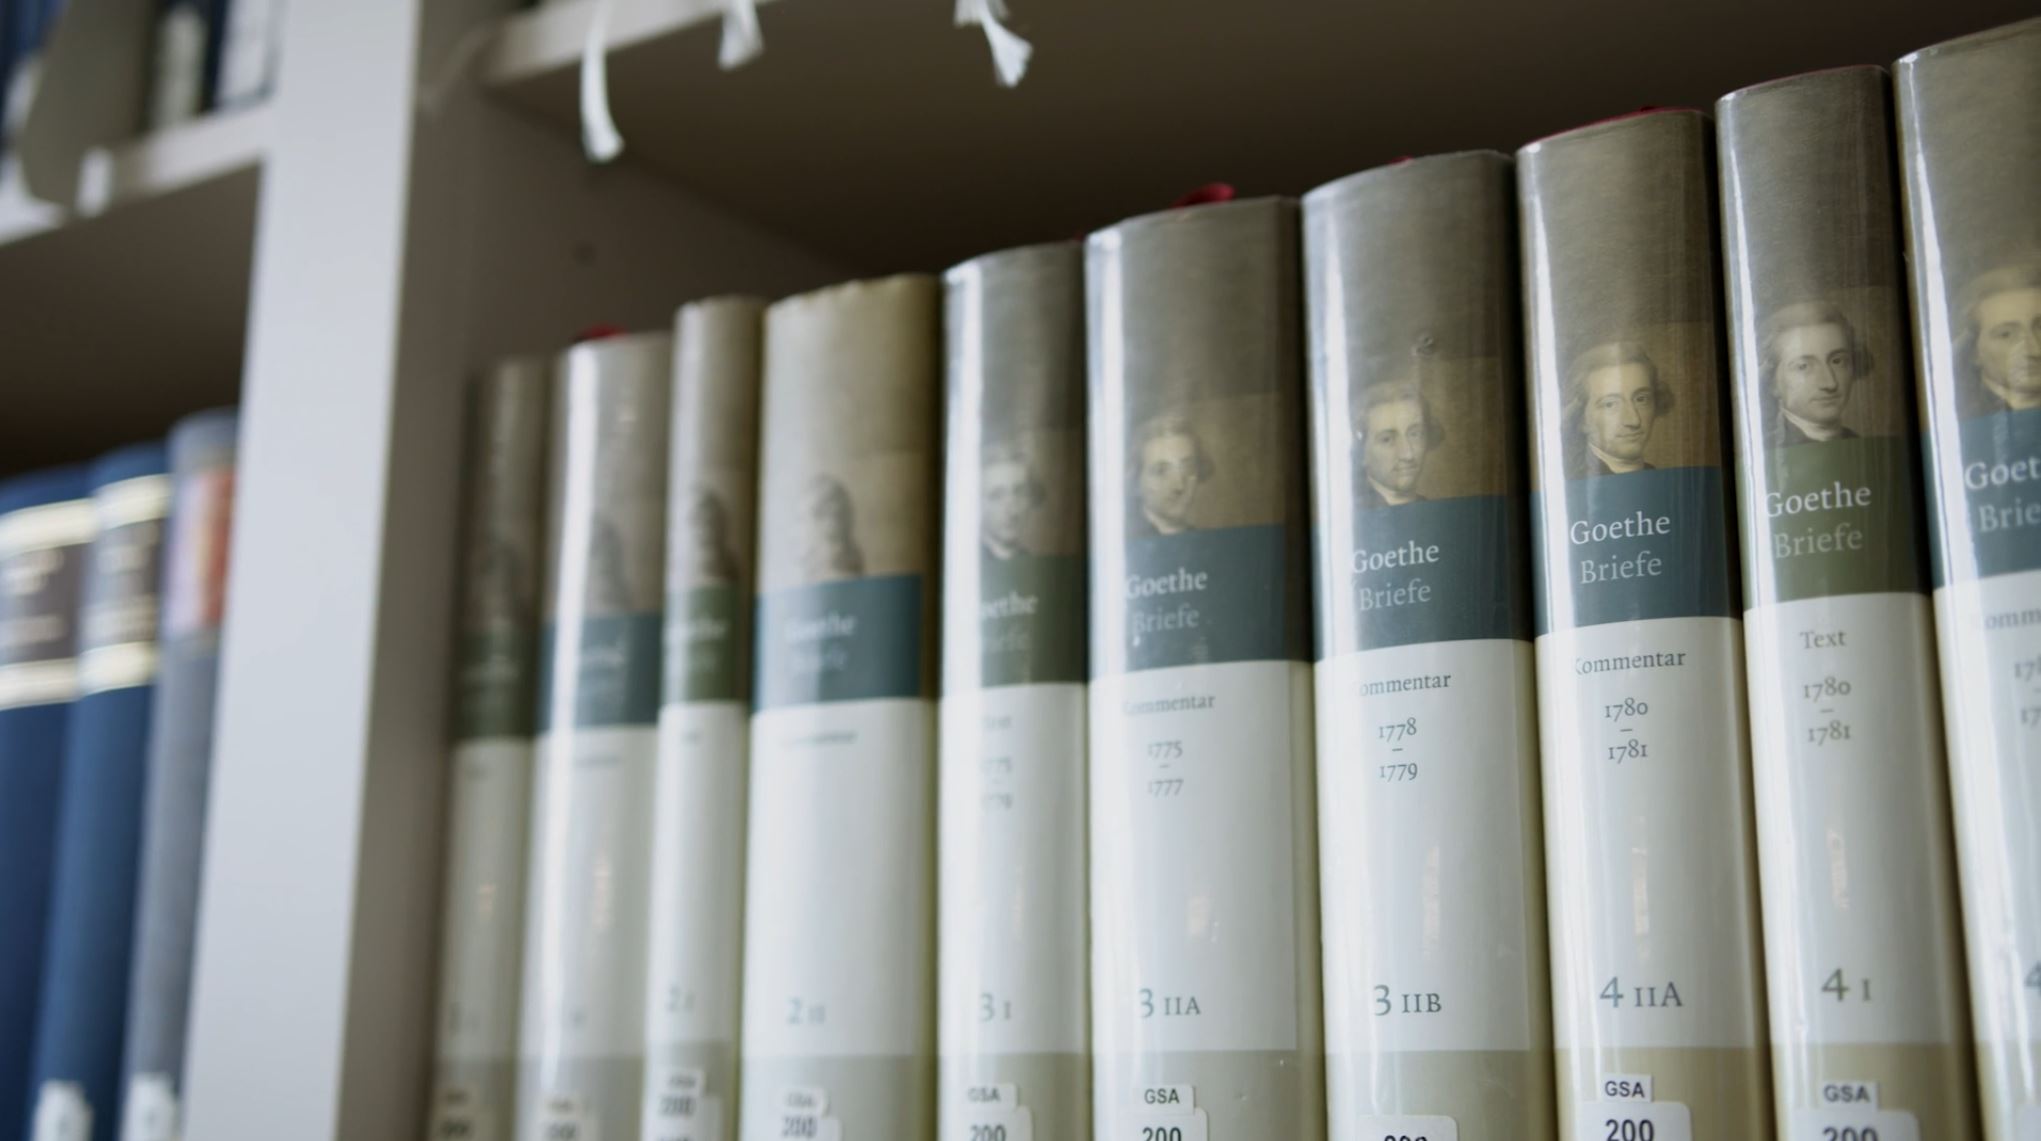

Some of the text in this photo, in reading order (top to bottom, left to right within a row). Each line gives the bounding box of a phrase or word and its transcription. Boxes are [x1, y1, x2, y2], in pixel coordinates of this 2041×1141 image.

[1766, 481, 1871, 518] Goethe
[1570, 510, 1671, 545] Goethe
[1775, 522, 1863, 559] Briefe
[1352, 540, 1440, 574] Goethe
[1581, 550, 1662, 584] Briefe
[1126, 566, 1208, 599] Goethe
[1359, 577, 1431, 611] Briefe
[1985, 609, 2041, 631] omm
[1799, 629, 1847, 649] Text
[1360, 674, 1451, 697] ommentar
[1804, 676, 1852, 703] 1780
[1605, 697, 1648, 722] 1780
[1379, 716, 1417, 742] 1778
[1808, 719, 1851, 747] 1781
[1147, 739, 1183, 759] 1775
[1608, 738, 1648, 765] 1781
[1380, 762, 1418, 783] 1779
[1147, 777, 1185, 798] 1777
[1600, 976, 1684, 1008] 4 IIA
[1822, 968, 1850, 1001] 4
[979, 992, 996, 1022] 3
[1139, 988, 1202, 1018] 3 IIA
[1374, 984, 1443, 1016] 3 IIB
[967, 1087, 1002, 1104] GSA
[1144, 1088, 1180, 1105] GSA
[1604, 1080, 1646, 1099] GSA
[1823, 1084, 1871, 1104] GSA
[1142, 1127, 1182, 1141] 200
[1605, 1118, 1655, 1141] 200
[1823, 1127, 1879, 1141] 200
